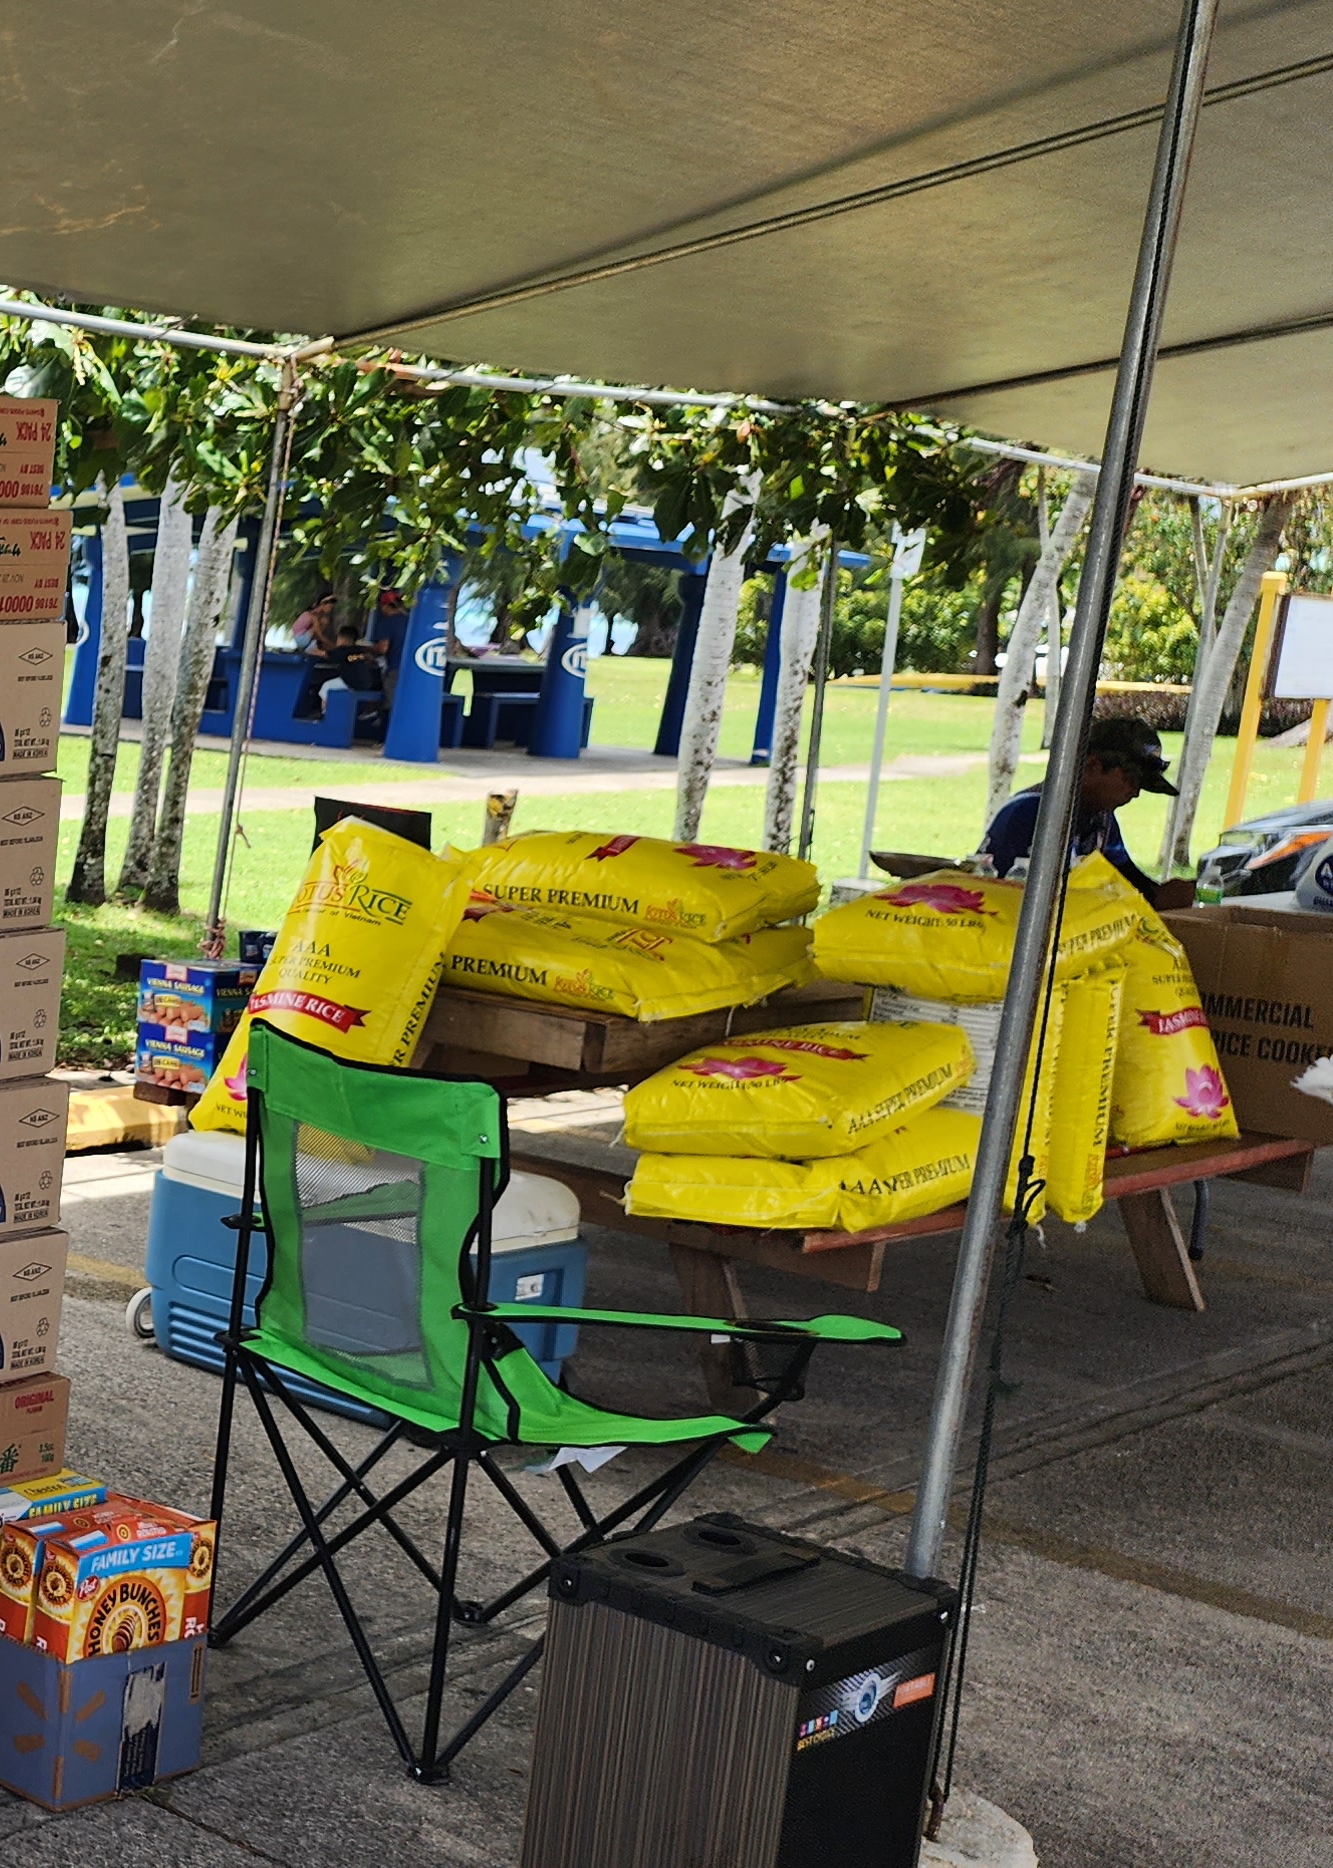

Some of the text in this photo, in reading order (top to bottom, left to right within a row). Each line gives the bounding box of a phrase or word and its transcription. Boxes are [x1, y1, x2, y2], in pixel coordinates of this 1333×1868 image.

[15, 421, 52, 442] 24 PACK
[29, 530, 65, 550] 24 PACK
[348, 883, 412, 922] RICE
[483, 883, 640, 915] SUPER PREMIUM
[291, 939, 331, 958] AAA
[278, 966, 334, 985] QUALITY
[298, 956, 361, 979] PREMIUM
[451, 954, 547, 986] PREMIUM
[304, 997, 345, 1023] RICE
[14, 1389, 55, 1409] ORIGINAL
[90, 1541, 177, 1574] FAMILY SIZE
[88, 1582, 161, 1657] HONEY BUNCHES
